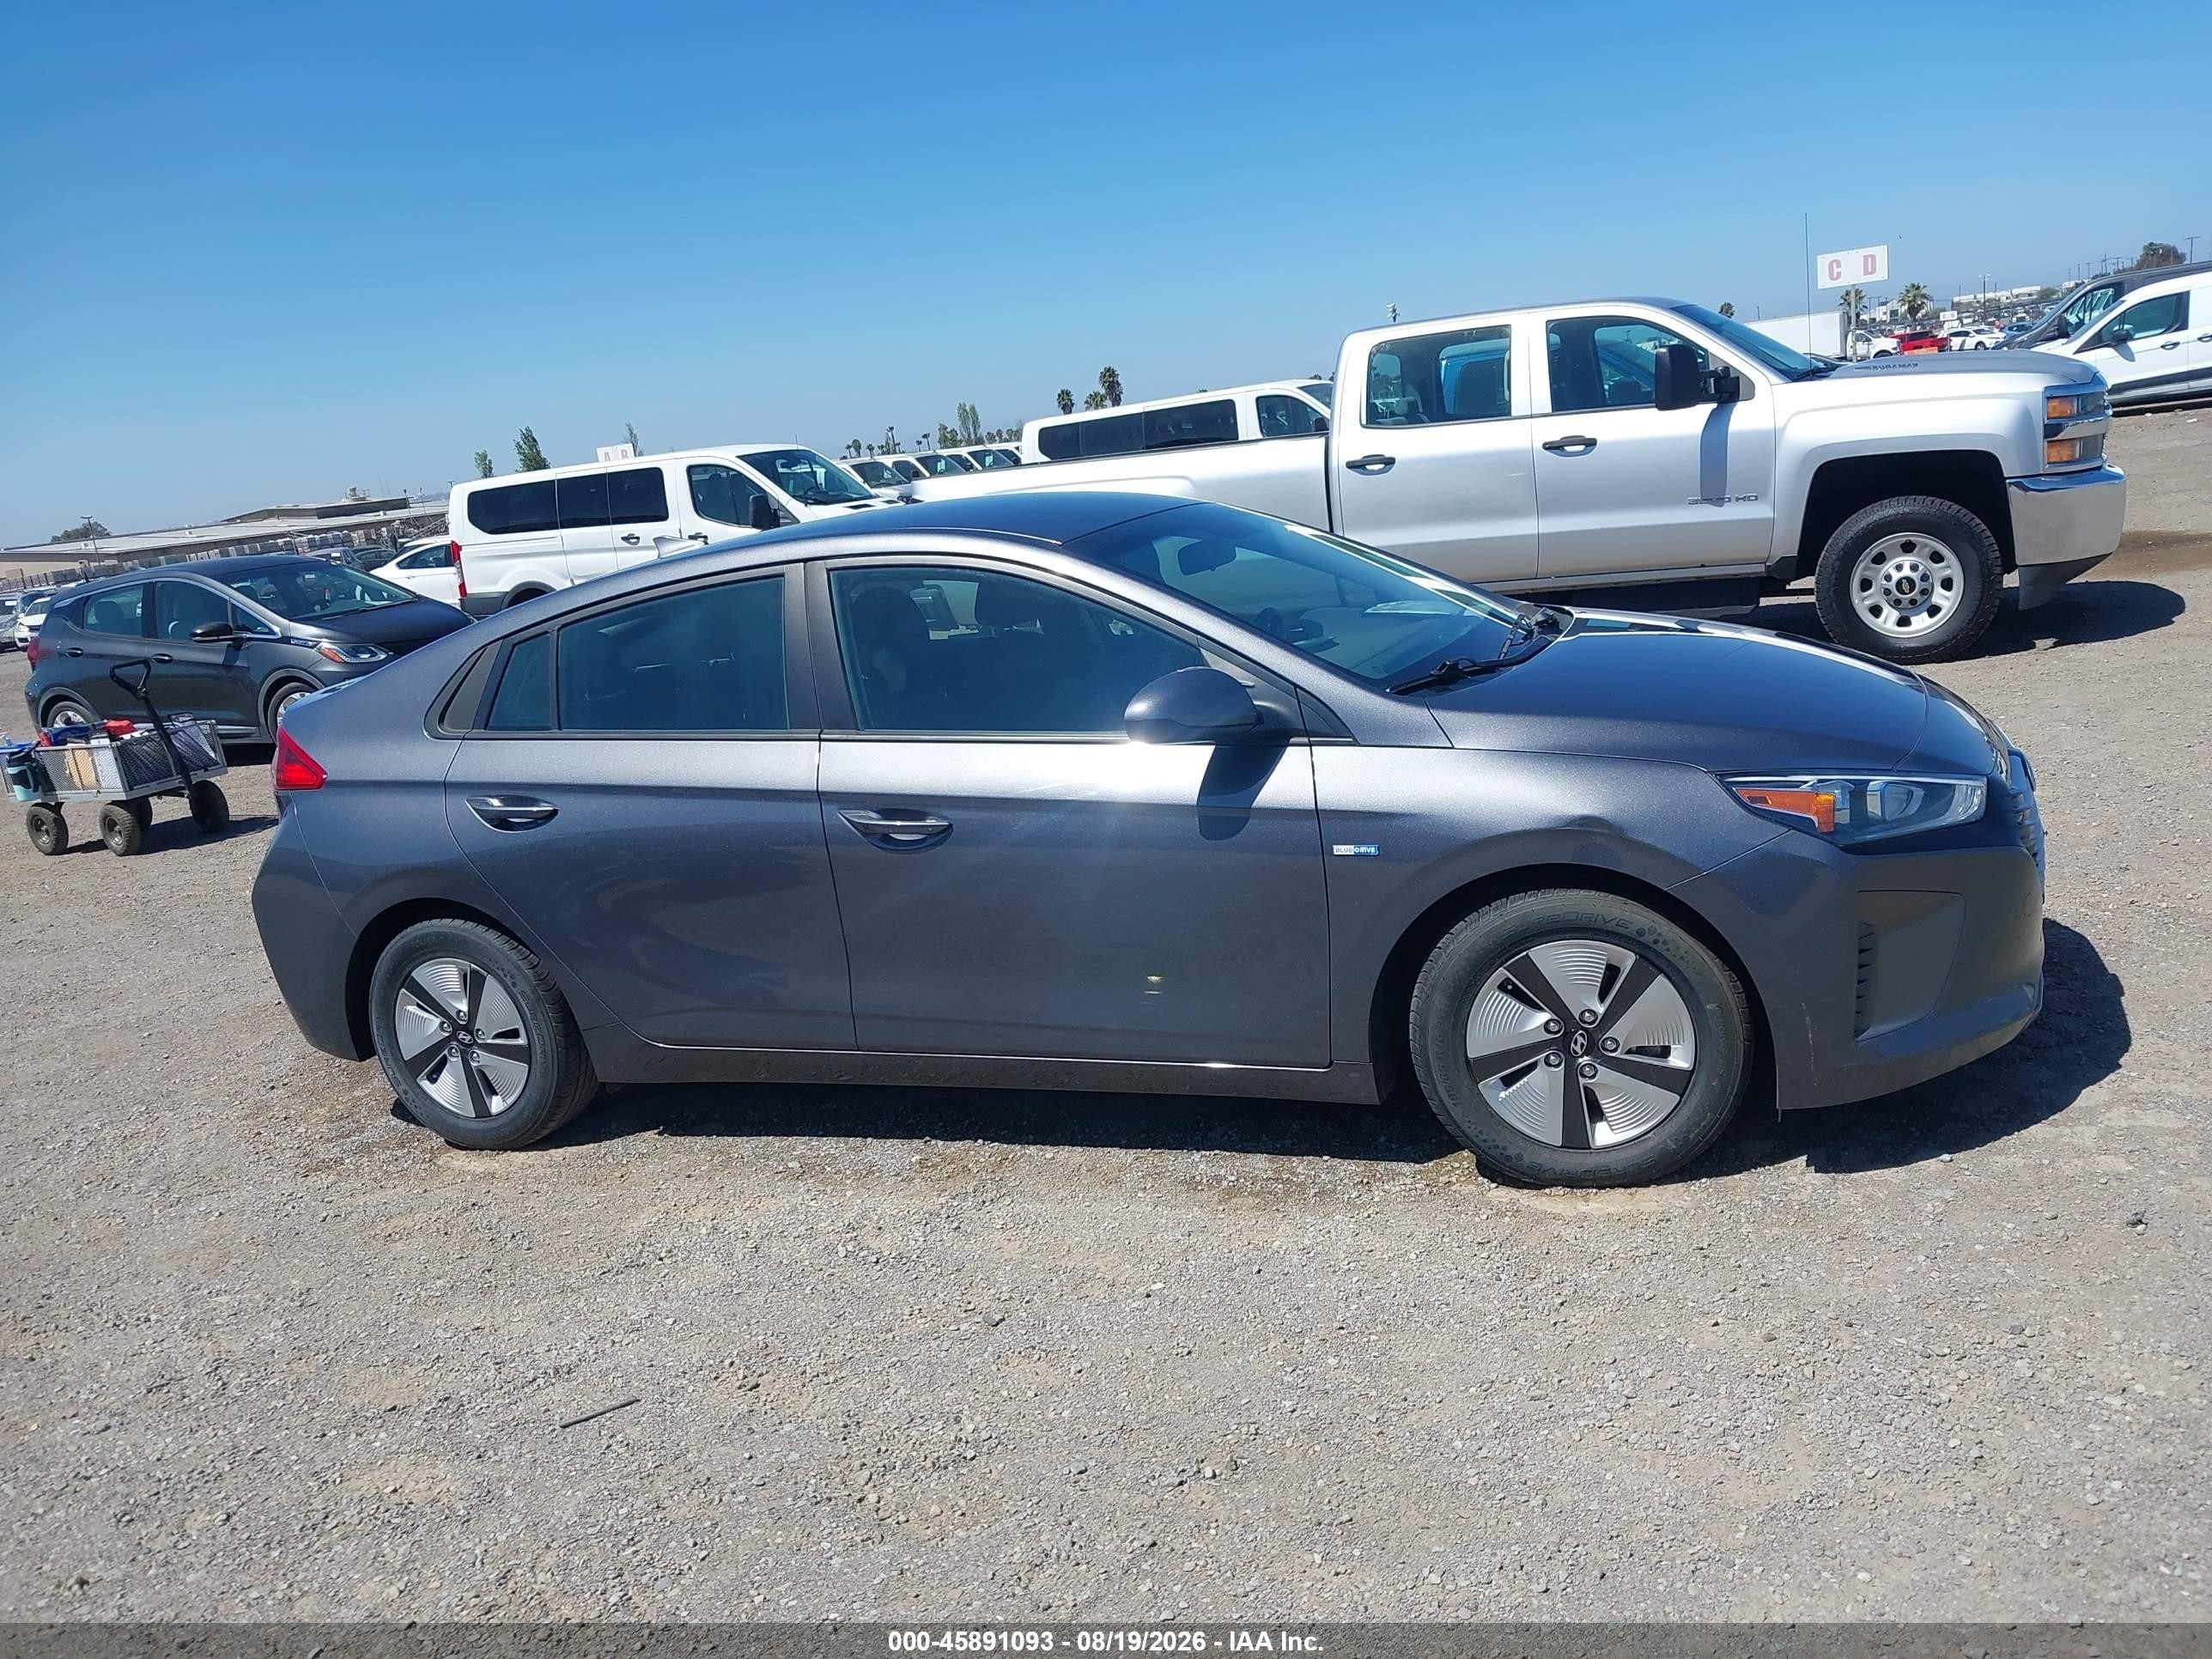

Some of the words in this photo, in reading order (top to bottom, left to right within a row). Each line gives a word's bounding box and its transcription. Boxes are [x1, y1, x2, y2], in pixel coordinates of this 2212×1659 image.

[1827, 258, 1842, 282] C
[1863, 253, 1877, 276] D
[1735, 494, 1759, 502] HD
